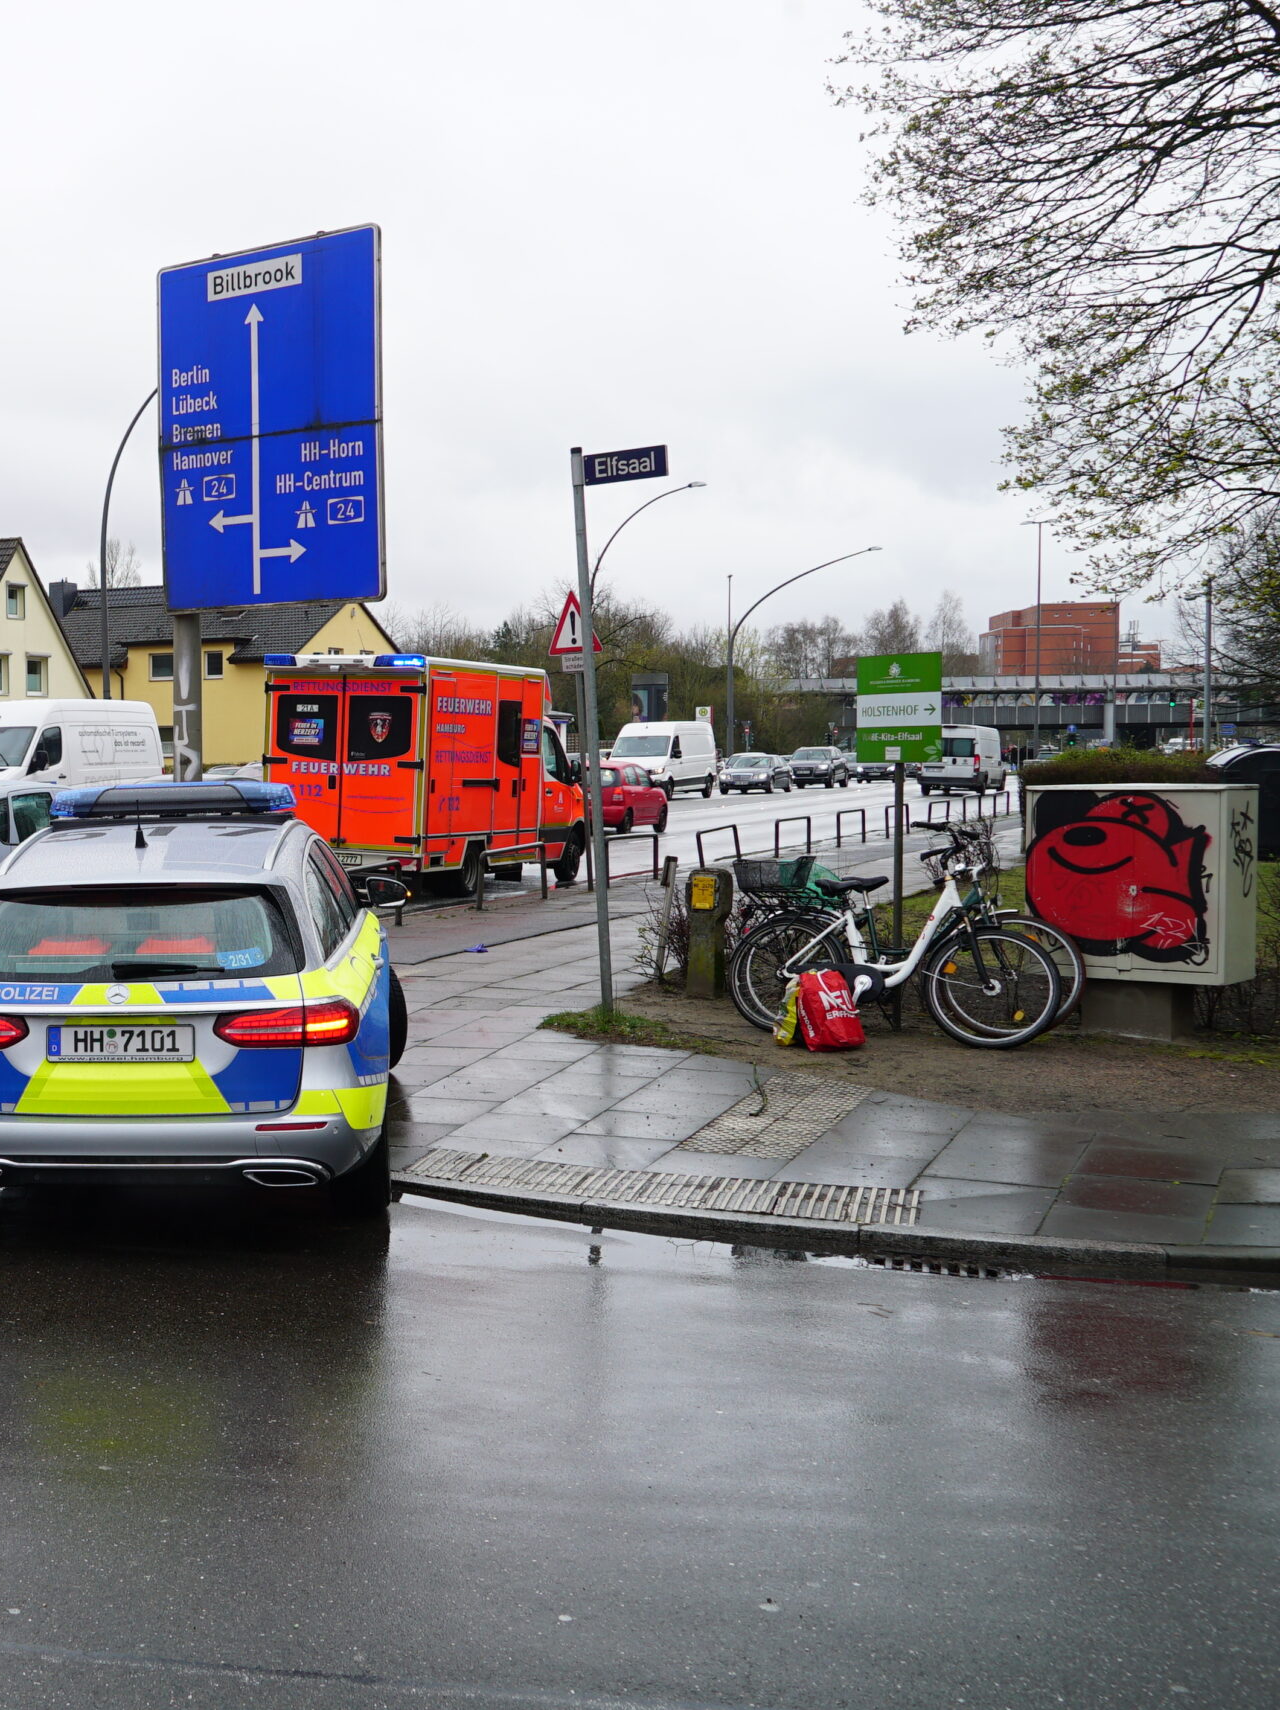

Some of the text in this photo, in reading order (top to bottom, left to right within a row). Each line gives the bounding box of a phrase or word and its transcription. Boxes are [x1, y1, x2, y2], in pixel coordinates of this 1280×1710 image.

[213, 262, 296, 296] Billbrook
[172, 365, 210, 388] Berlin
[172, 391, 217, 415] Lübeck
[173, 423, 221, 443] Bremen
[173, 446, 234, 471] Hannover
[301, 438, 364, 463] HH-Horn
[594, 451, 656, 479] Elfsaal
[211, 480, 228, 496] 24
[276, 469, 365, 495] HH-Centrum
[336, 502, 356, 519] 24
[294, 681, 393, 693] RETTUNGSDIENST
[437, 696, 492, 716] FEUERWEHR
[861, 704, 920, 718] HOLSTENHOF
[436, 723, 466, 734] HAMBURG
[435, 750, 492, 763] RETTUNGSDIENST
[292, 761, 391, 776] FEUERWEHR
[300, 784, 323, 797] 112
[341, 855, 358, 863] 2777
[74, 1029, 180, 1053] HH 7101
